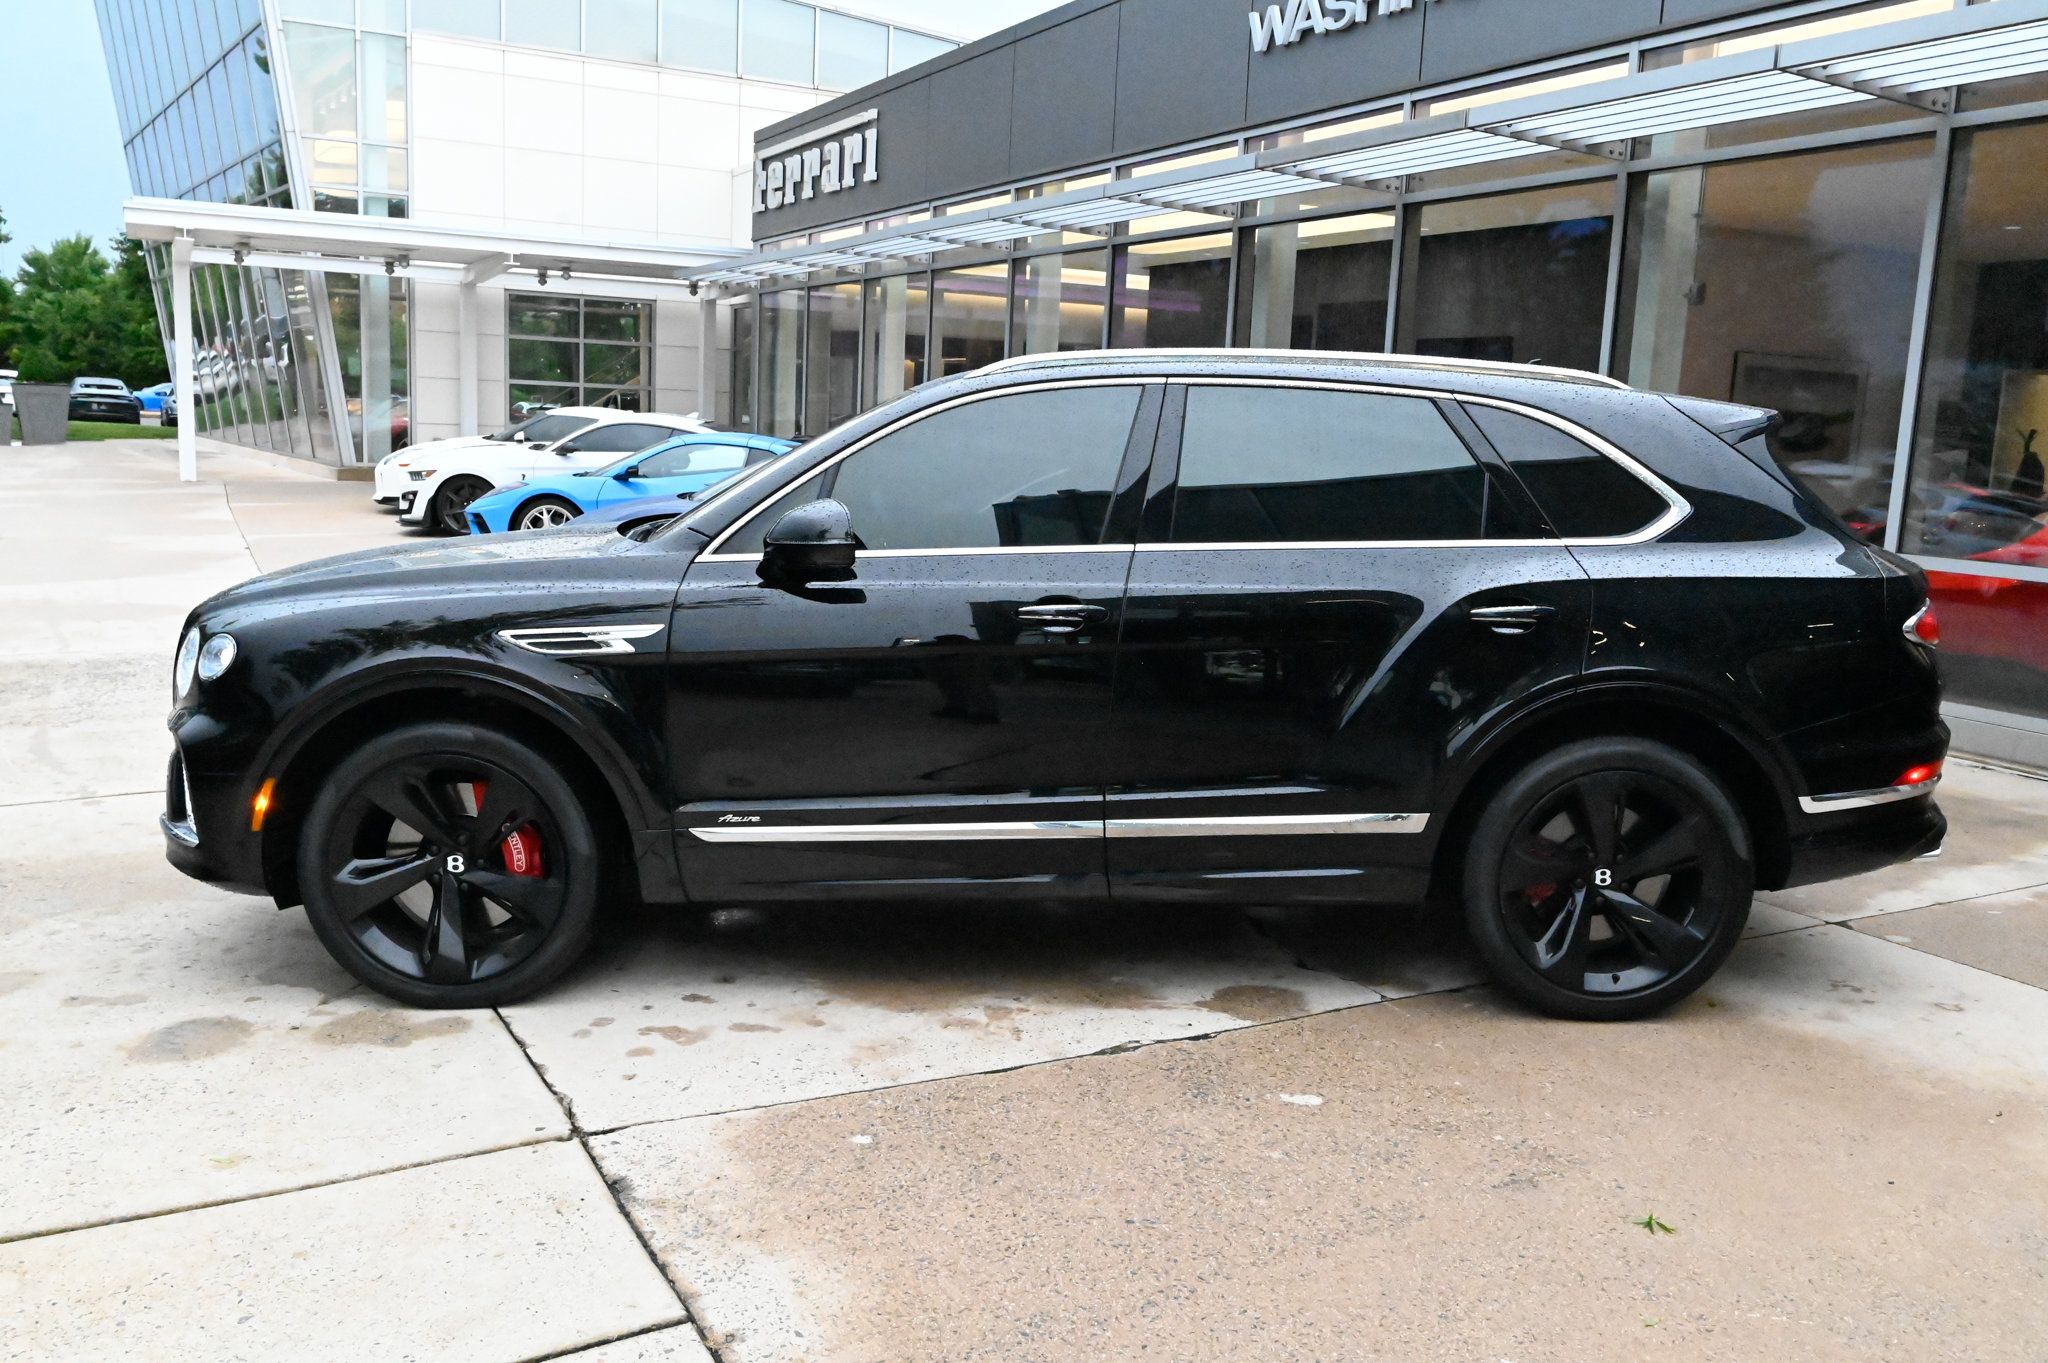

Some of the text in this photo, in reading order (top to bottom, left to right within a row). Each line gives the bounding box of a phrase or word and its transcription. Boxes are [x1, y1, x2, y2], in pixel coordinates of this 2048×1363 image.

[752, 108, 878, 213] Ferrari
[717, 814, 761, 823] Azure
[510, 830, 524, 867] ENTLEY
[446, 855, 465, 873] B
[1594, 868, 1612, 886] B
